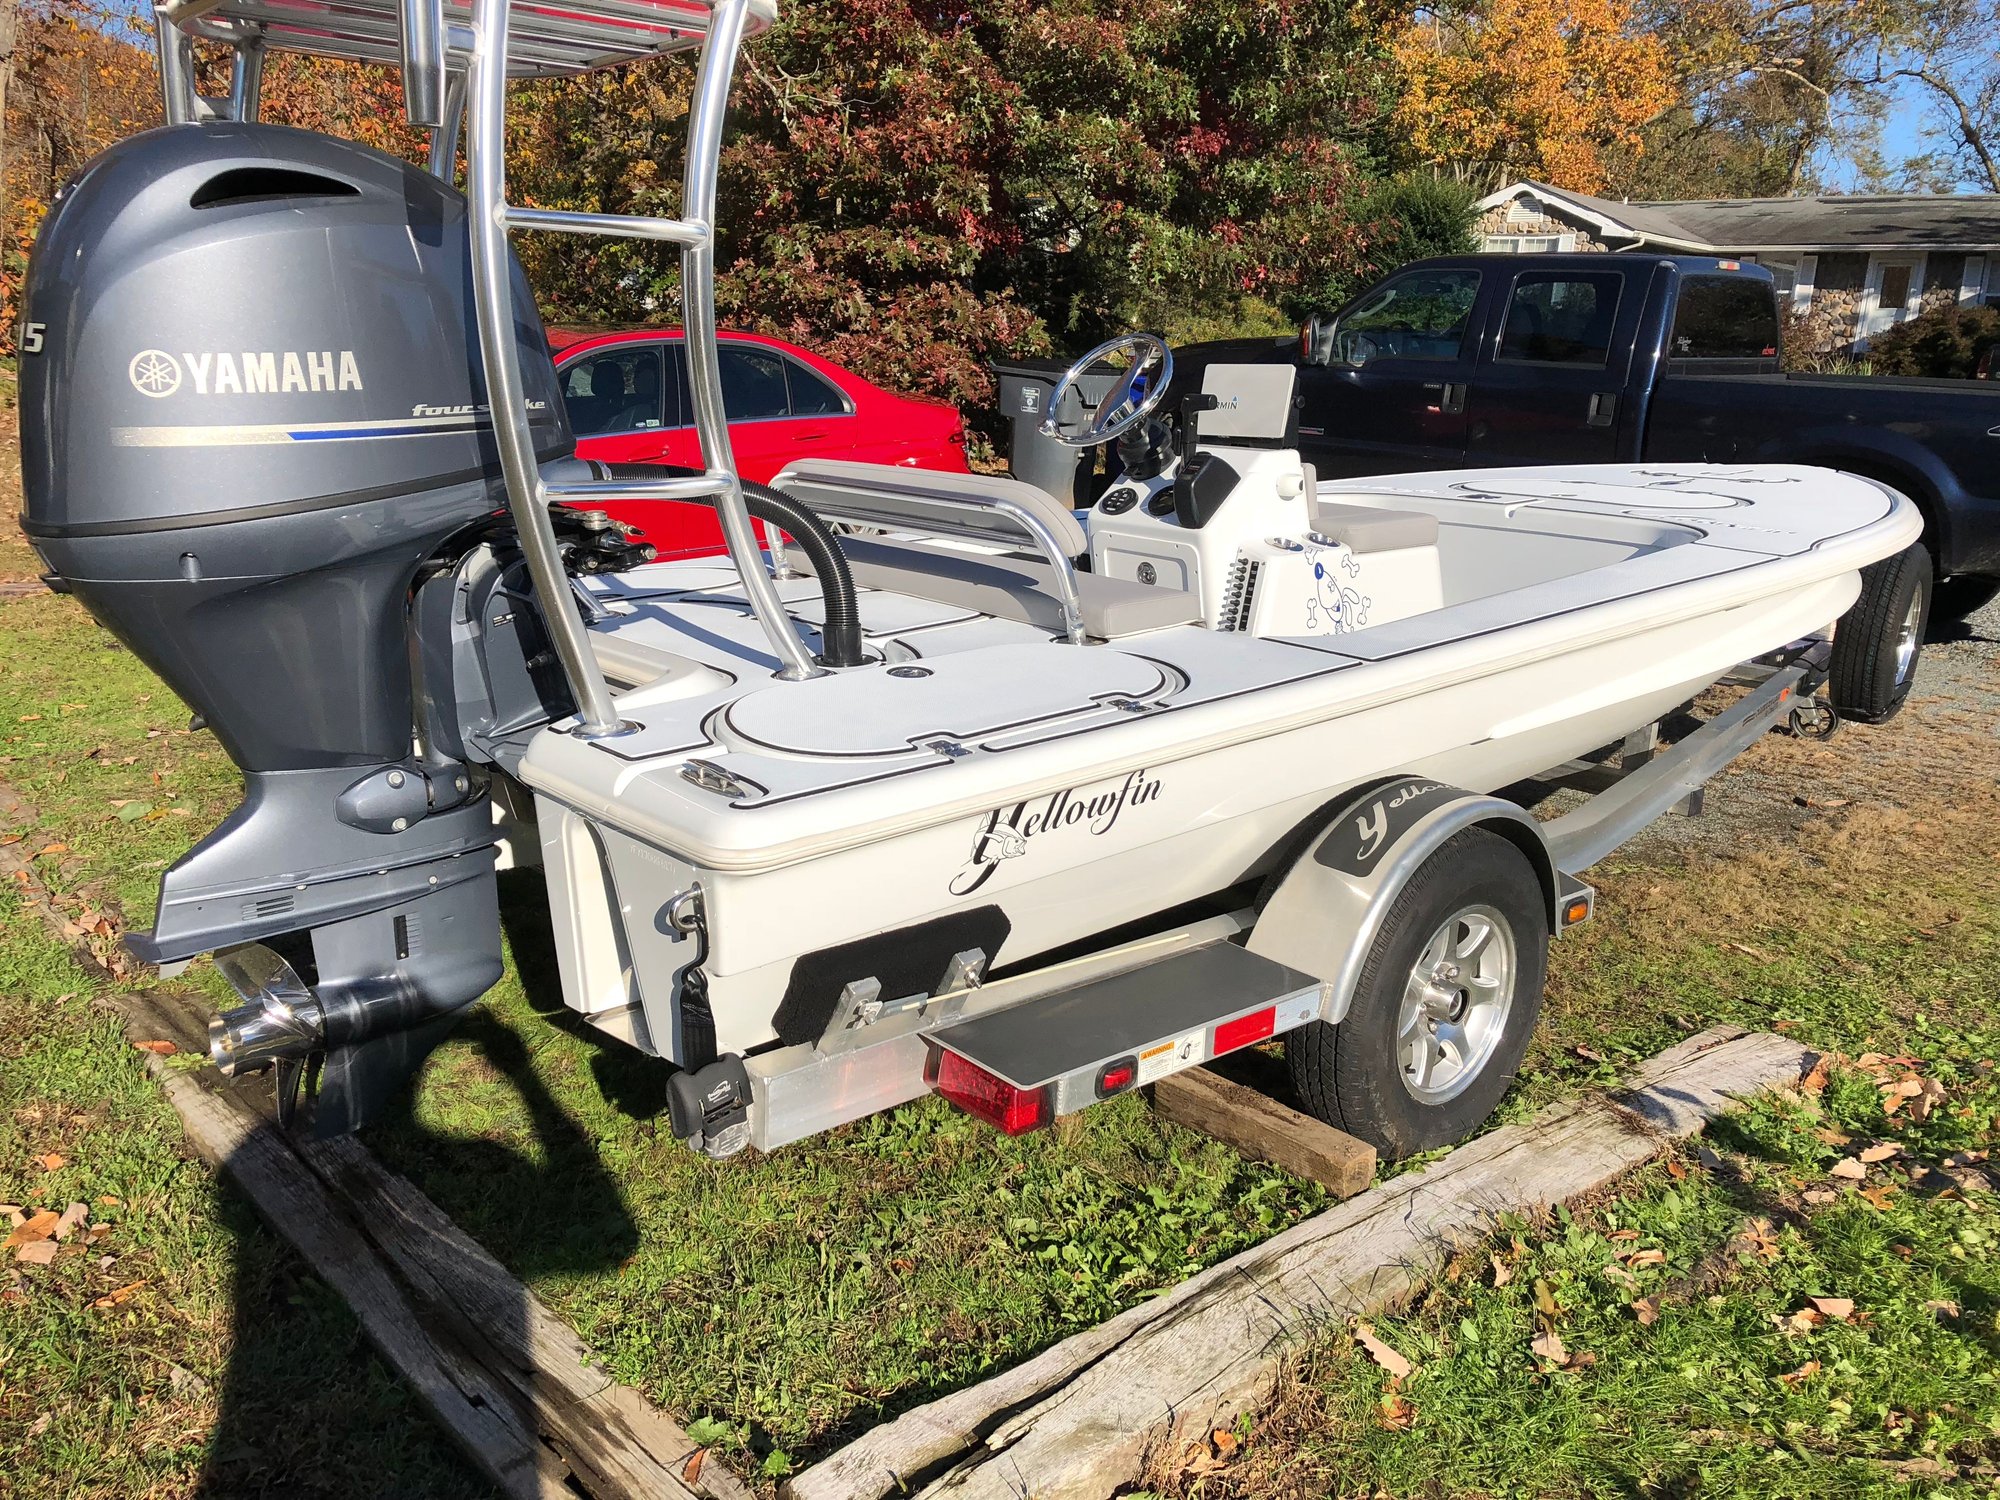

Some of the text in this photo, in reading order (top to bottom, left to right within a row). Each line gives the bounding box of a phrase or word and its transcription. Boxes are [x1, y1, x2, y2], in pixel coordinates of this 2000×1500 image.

[182, 350, 364, 394] YAMAHA
[411, 398, 546, 417] fourske
[948, 769, 1166, 896] Yellowfin
